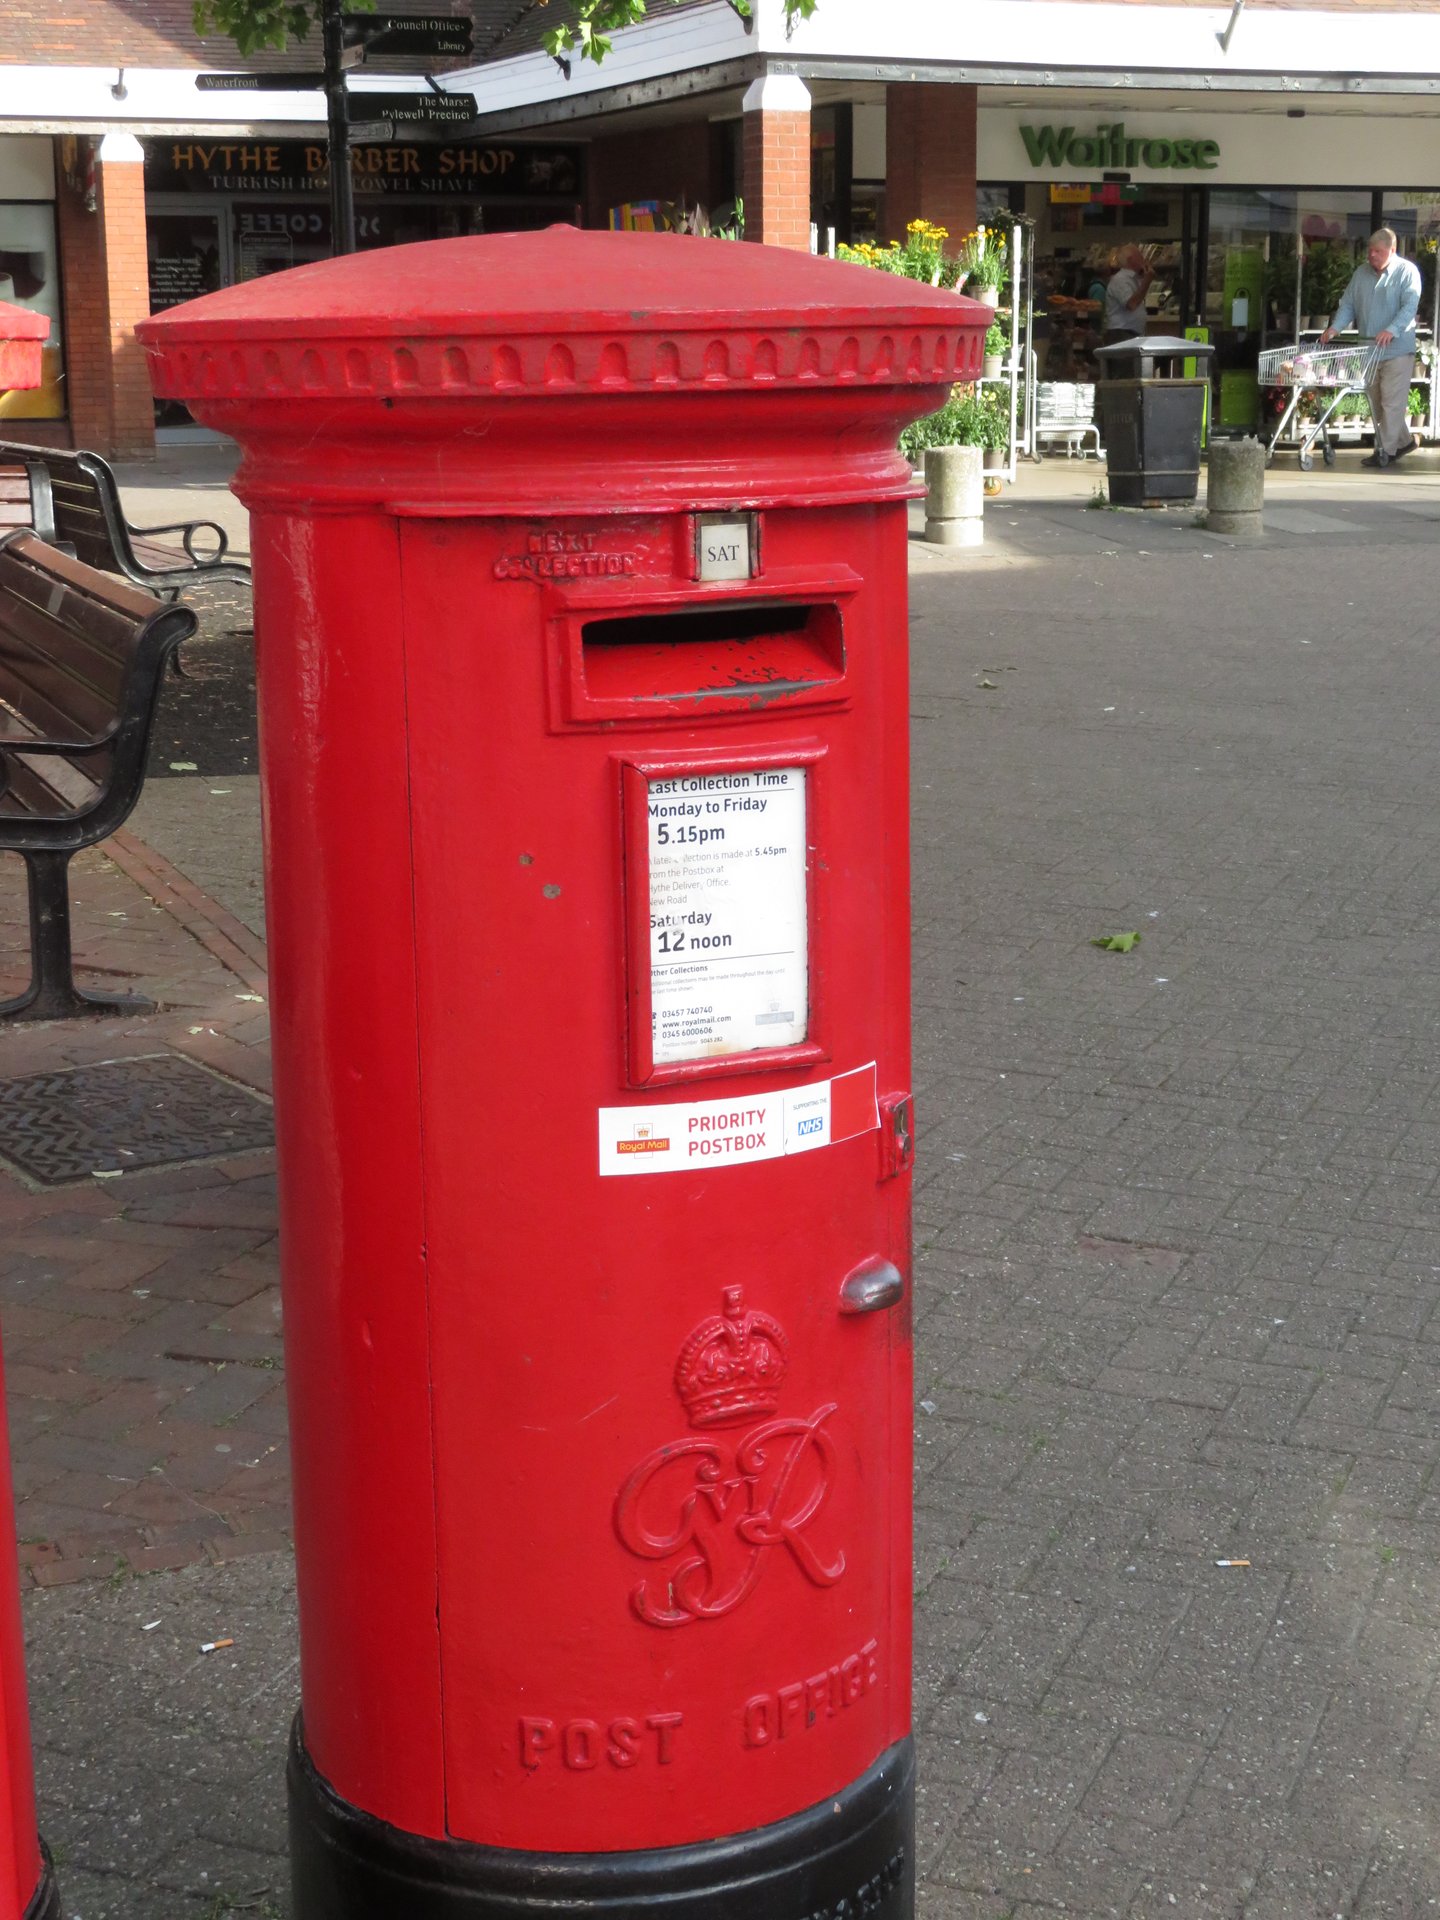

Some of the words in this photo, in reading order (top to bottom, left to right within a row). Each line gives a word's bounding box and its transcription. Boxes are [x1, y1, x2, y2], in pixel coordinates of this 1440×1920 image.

[388, 20, 428, 31] Council
[438, 41, 466, 53] Library
[204, 78, 260, 88] Waterfront
[418, 97, 437, 106] The
[382, 110, 425, 120] Pylewell
[1019, 122, 1221, 170] Waitrose
[172, 145, 281, 171] HYTHE
[439, 149, 515, 175] SHOP
[209, 176, 293, 190] TURKISH
[301, 176, 328, 190] HO
[352, 178, 416, 192] TOWEL
[707, 545, 740, 562] SAT
[648, 780, 678, 794] Last
[682, 776, 750, 792] Collection
[754, 772, 788, 786] Time
[648, 803, 702, 818] Monday
[706, 802, 720, 814] to
[724, 798, 768, 814] Friday
[657, 823, 726, 845] 5.15pm
[721, 851, 744, 859] made
[755, 846, 787, 856] 5.45pm
[649, 871, 666, 880] rom
[668, 868, 681, 877] the
[682, 866, 715, 876] Postbox
[672, 882, 704, 891] Deliver
[667, 895, 688, 904] Road
[650, 912, 712, 928] Saturday
[658, 931, 686, 953] 12
[690, 934, 732, 950] noon
[670, 965, 708, 975] Collections
[662, 1008, 684, 1018] 03457
[686, 1006, 713, 1015] 740740
[662, 1015, 732, 1028] www.royalmail.com
[681, 1027, 713, 1036] 6000606
[688, 1108, 766, 1132] PRIORITY
[800, 1117, 822, 1134] NHS
[619, 1140, 647, 1152] Royal
[648, 1139, 668, 1150] Mail
[688, 1132, 766, 1156] POSTBOX
[743, 1638, 879, 1749] OFFICE
[518, 1712, 685, 1770] POST
